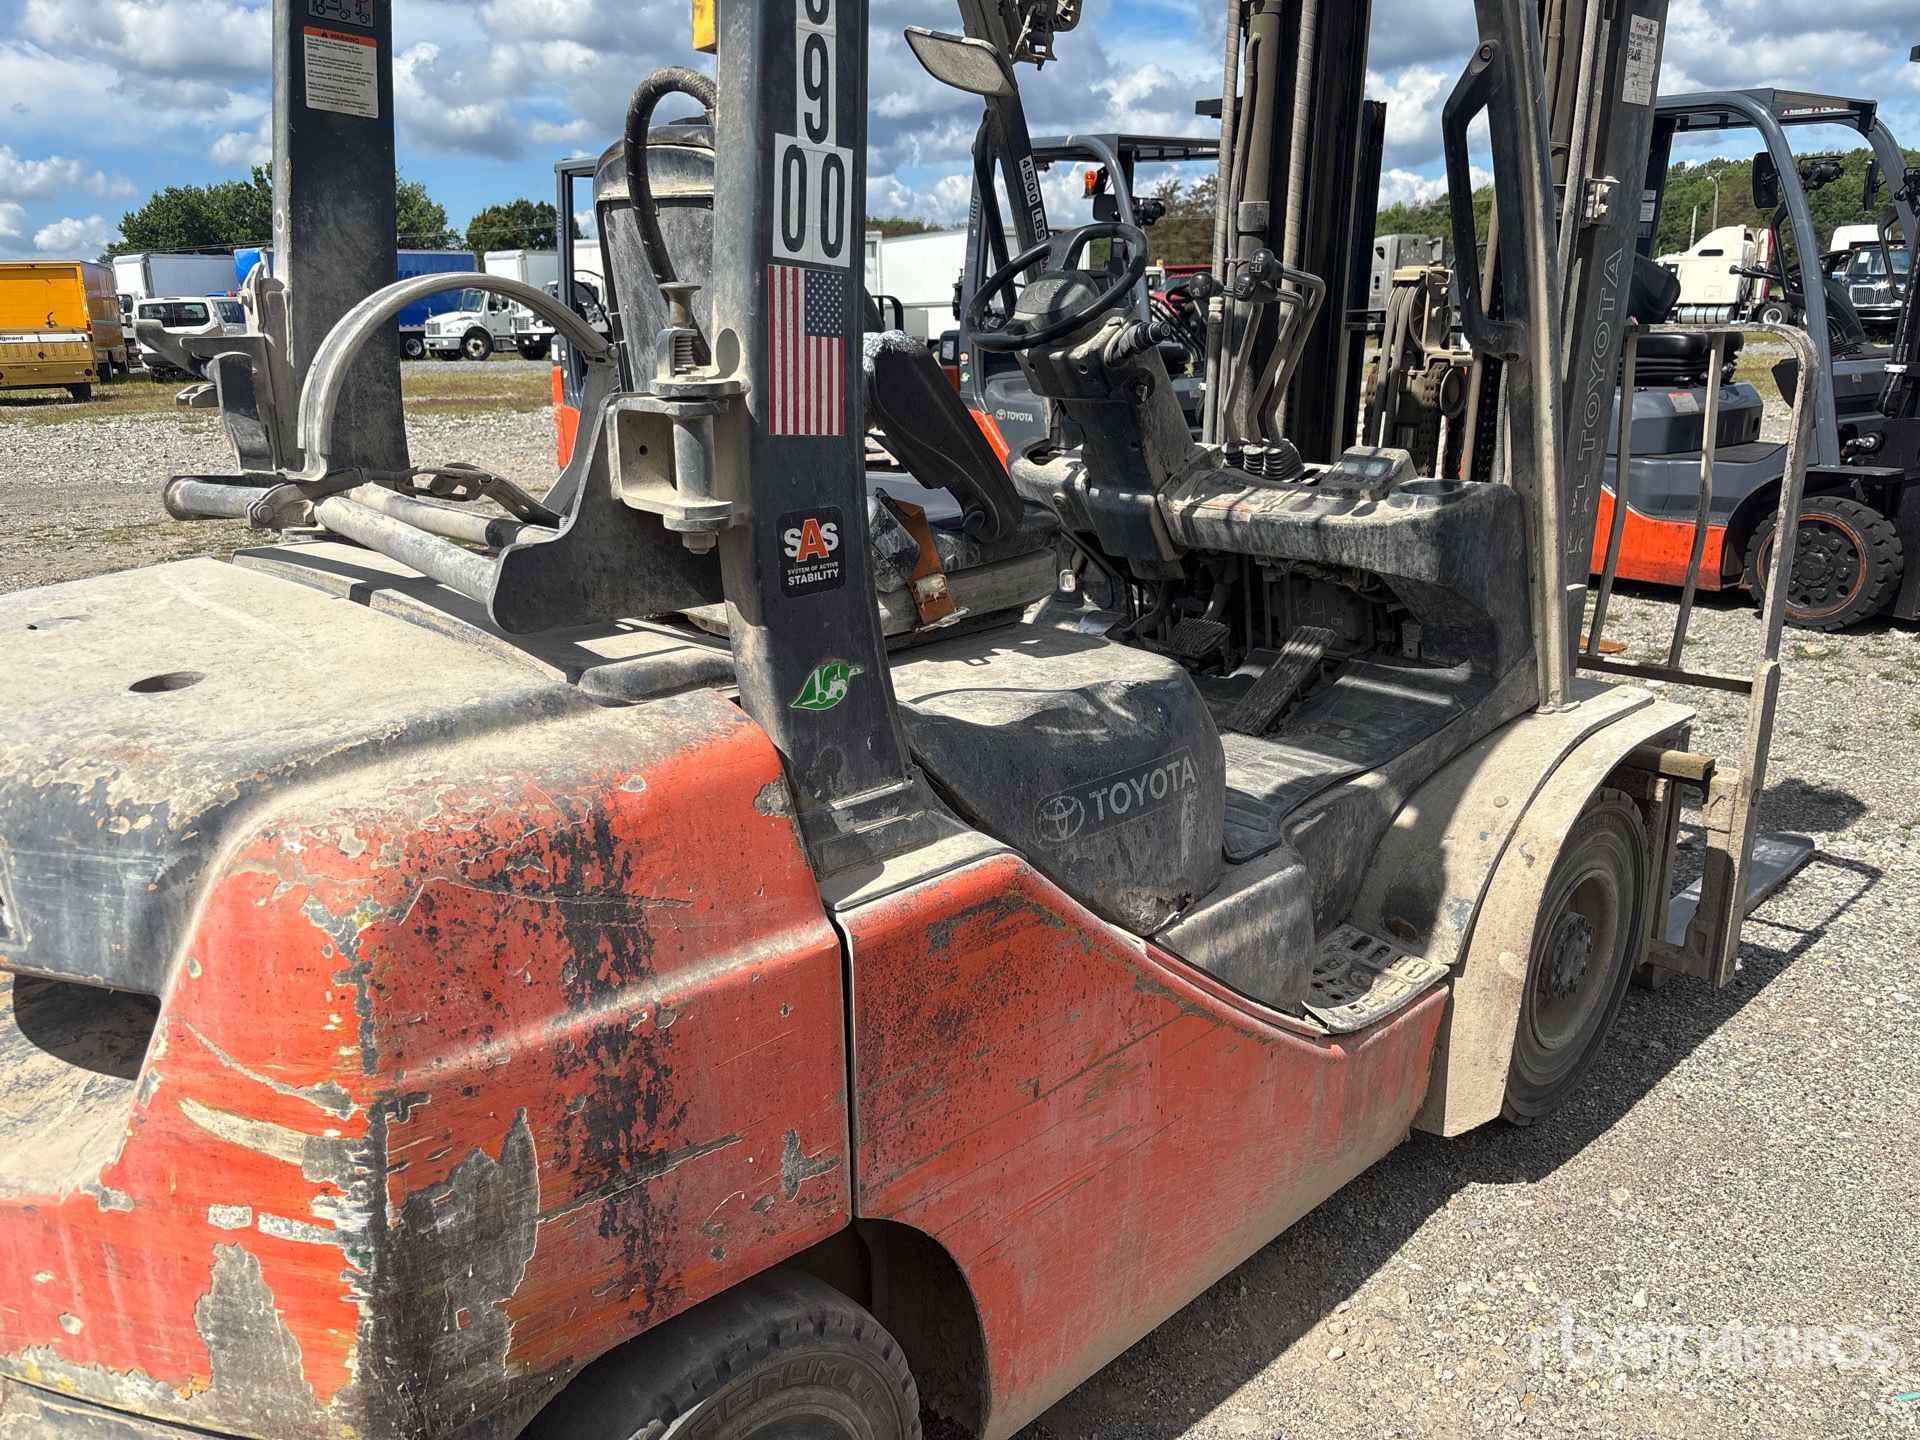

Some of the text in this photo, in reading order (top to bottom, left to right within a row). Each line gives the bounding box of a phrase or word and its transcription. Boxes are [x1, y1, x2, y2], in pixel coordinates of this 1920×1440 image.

[330, 32, 359, 44] WARNING
[1022, 159, 1038, 203] 4500
[1033, 208, 1046, 240] LBS
[1578, 247, 1623, 461] TOYOTA
[1007, 411, 1034, 423] TOYOTA
[784, 518, 839, 563] SAS
[787, 566, 810, 576] SYSTEM
[819, 561, 839, 570] ACTIVE
[788, 568, 840, 586] STABILITY
[1088, 756, 1197, 821] TOYOTA
